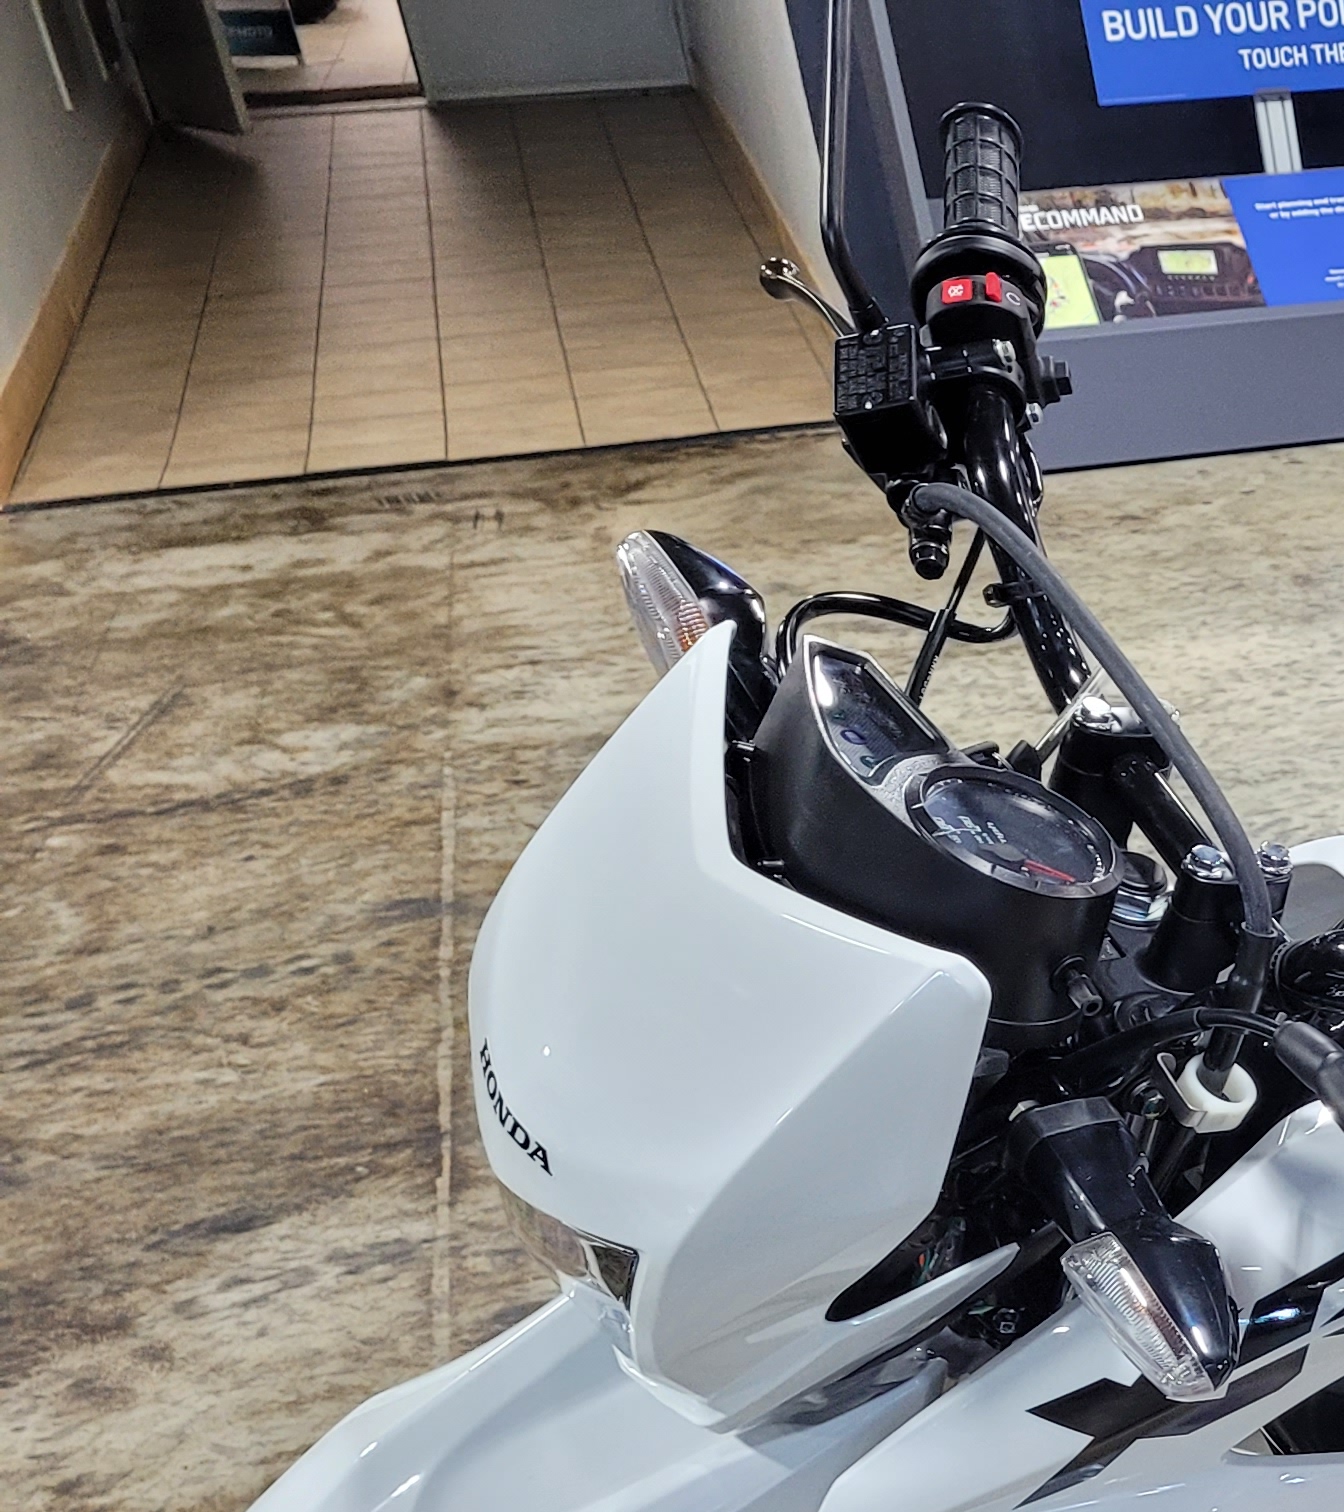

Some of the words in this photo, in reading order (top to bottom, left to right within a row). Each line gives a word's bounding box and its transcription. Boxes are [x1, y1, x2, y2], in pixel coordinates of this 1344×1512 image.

[1102, 9, 1199, 42] BUILD
[1203, 1, 1292, 36] YOUR
[1238, 45, 1309, 70] TOUCH
[480, 1037, 553, 1177] HONDA
